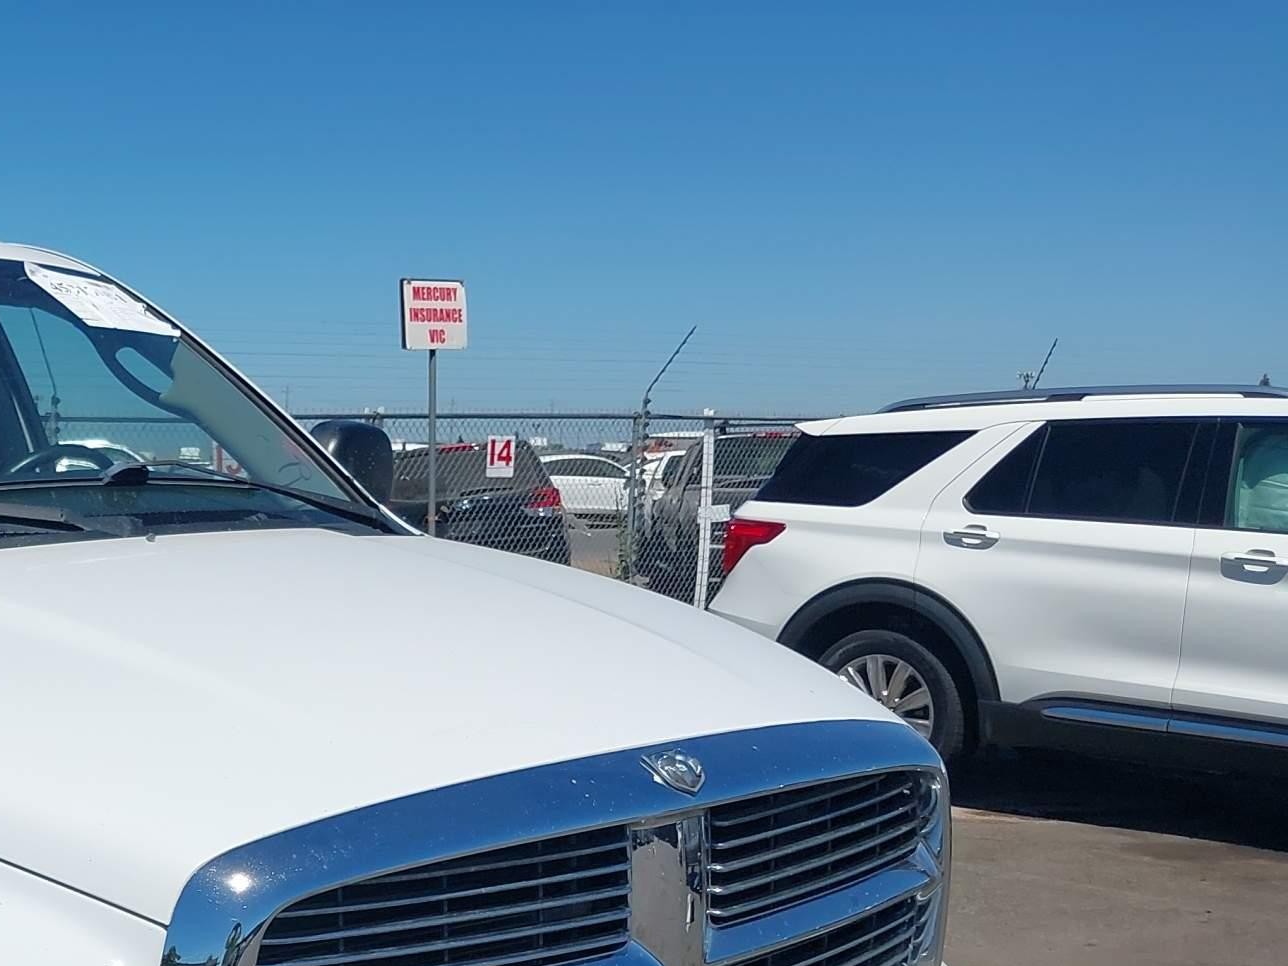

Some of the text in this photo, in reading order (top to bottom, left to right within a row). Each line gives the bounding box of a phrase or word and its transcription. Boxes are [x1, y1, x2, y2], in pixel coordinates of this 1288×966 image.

[412, 286, 457, 302] MERCURY
[409, 307, 463, 323] INSURANCE
[428, 329, 446, 344] VIC
[489, 439, 513, 466] 14
